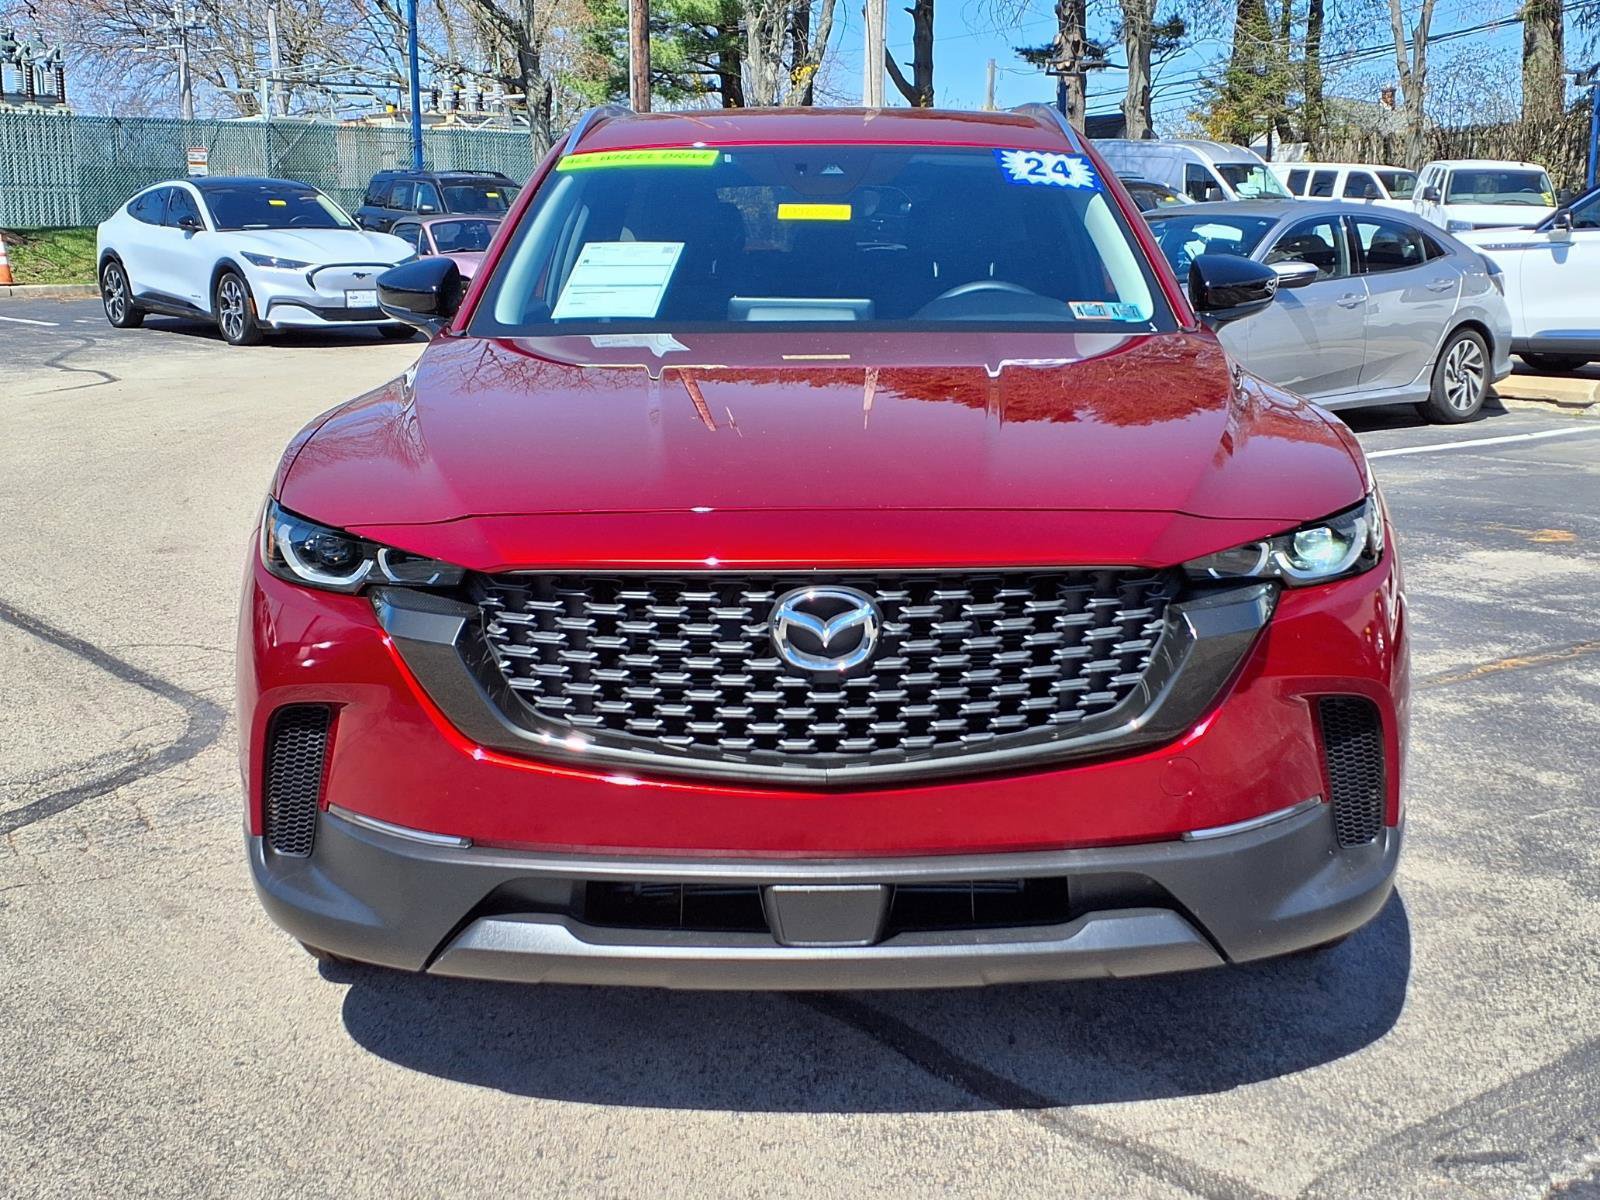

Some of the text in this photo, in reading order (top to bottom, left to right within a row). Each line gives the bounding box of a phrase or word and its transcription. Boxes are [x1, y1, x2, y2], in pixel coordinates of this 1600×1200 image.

[600, 153, 655, 161] WHEEL
[661, 152, 711, 160] DRIVE
[1024, 157, 1072, 179] 24
